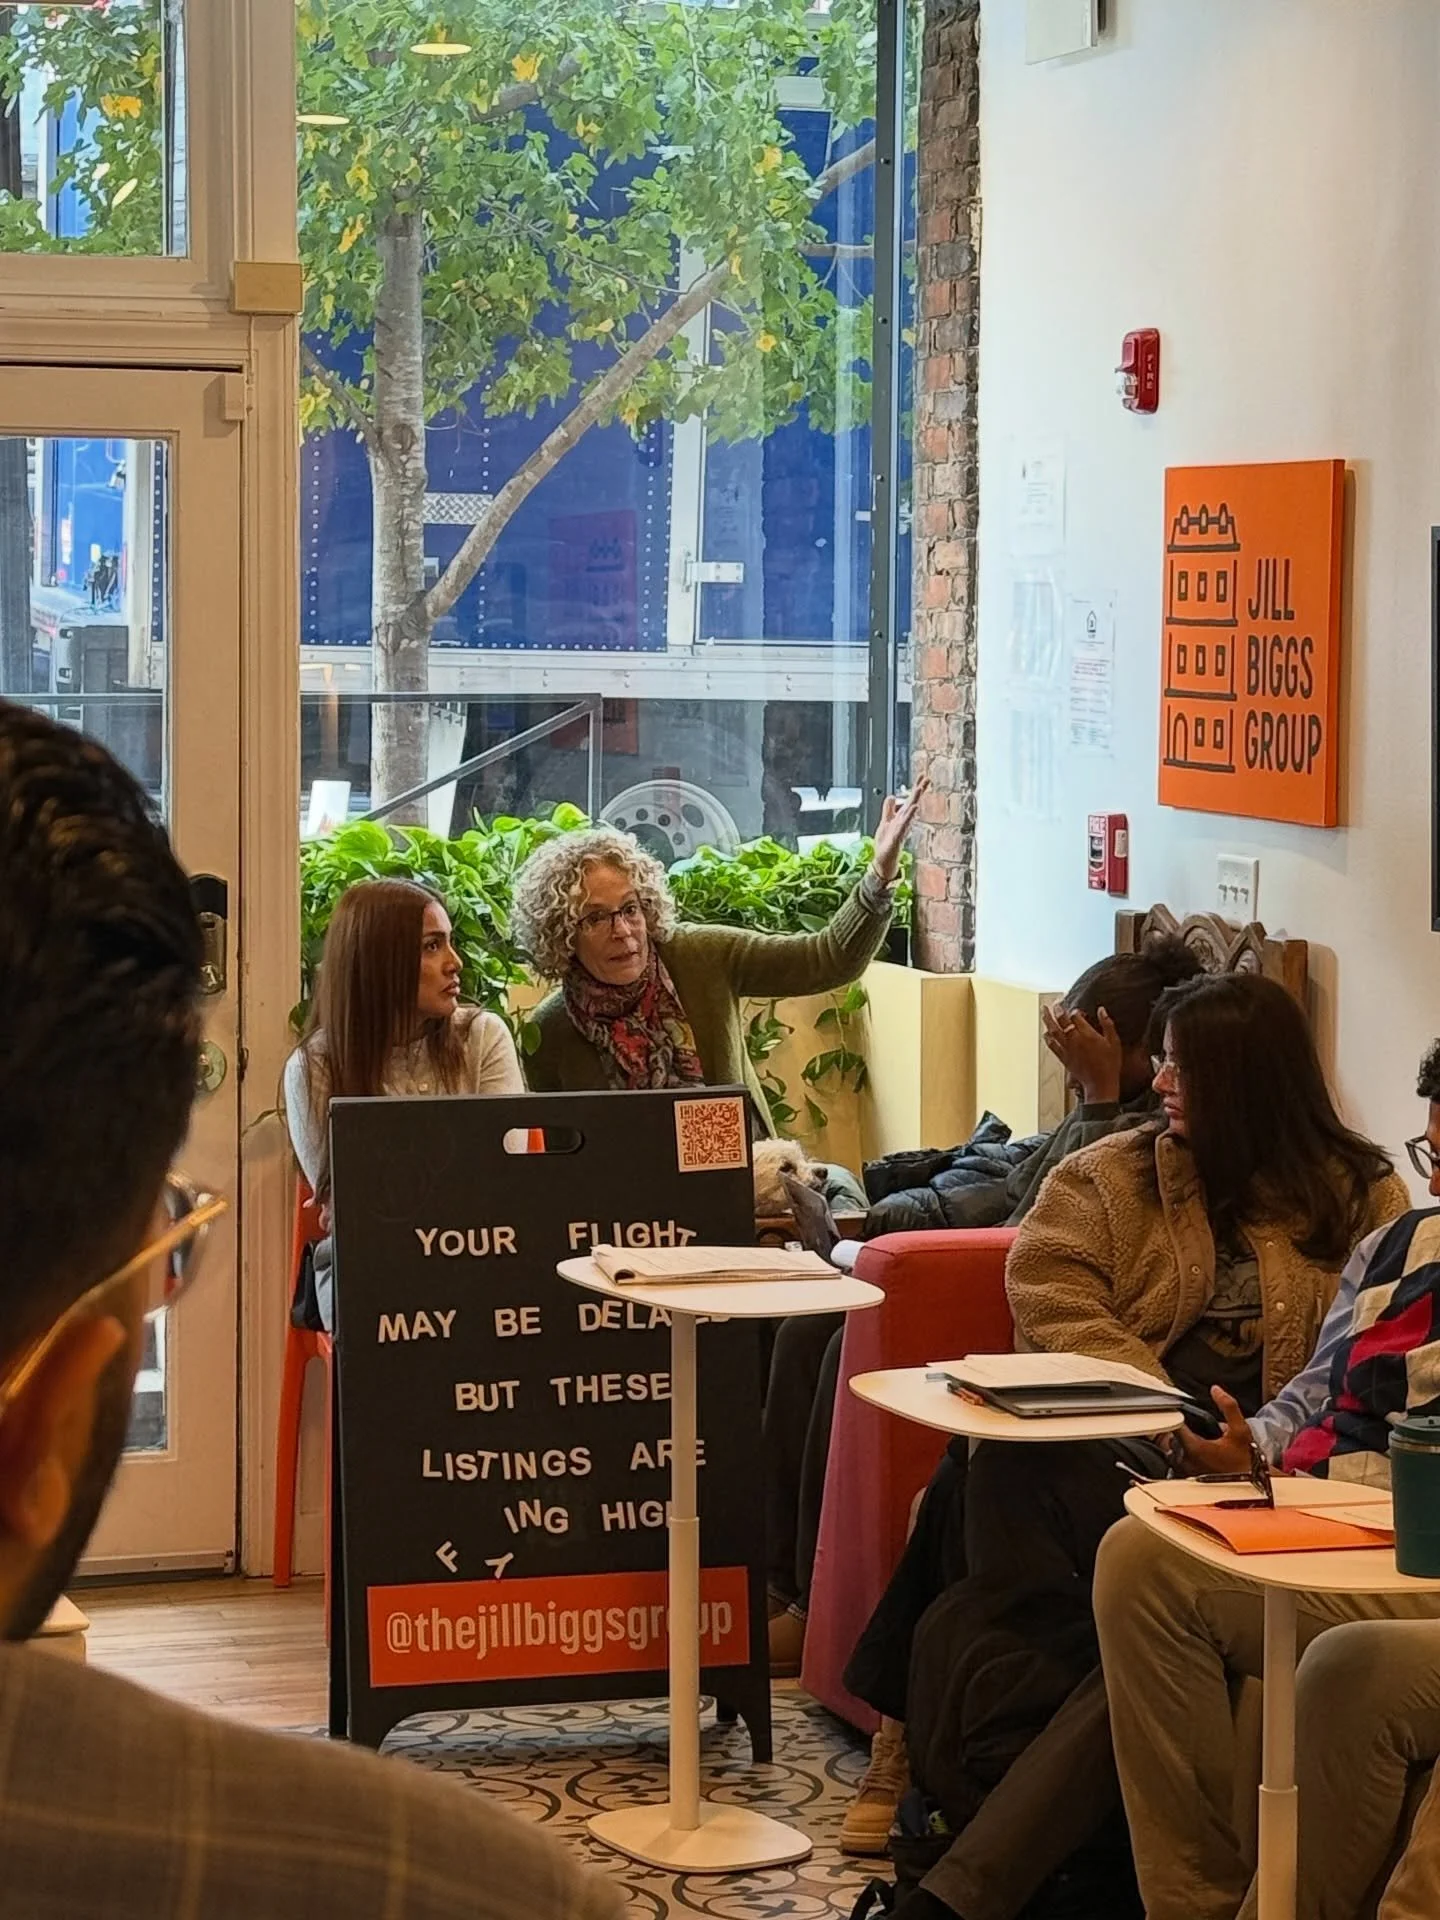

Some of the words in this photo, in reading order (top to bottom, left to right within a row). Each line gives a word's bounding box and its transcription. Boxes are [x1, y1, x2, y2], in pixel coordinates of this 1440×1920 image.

[1247, 558, 1295, 621] JILL
[1246, 634, 1314, 700] BIGGS
[1244, 709, 1322, 775] GROUP
[415, 1226, 518, 1257] YOUR
[568, 1219, 697, 1250] FLIGHT
[377, 1309, 457, 1344] MAY
[494, 1306, 542, 1337] BE
[455, 1380, 520, 1412] BUT
[550, 1372, 672, 1407] THESE
[422, 1447, 592, 1482] LISTINGS
[503, 1498, 569, 1534] ING
[601, 1500, 673, 1532] HIG
[435, 1540, 459, 1574] F
[386, 1600, 732, 1661] @thejillbiggsgrup
